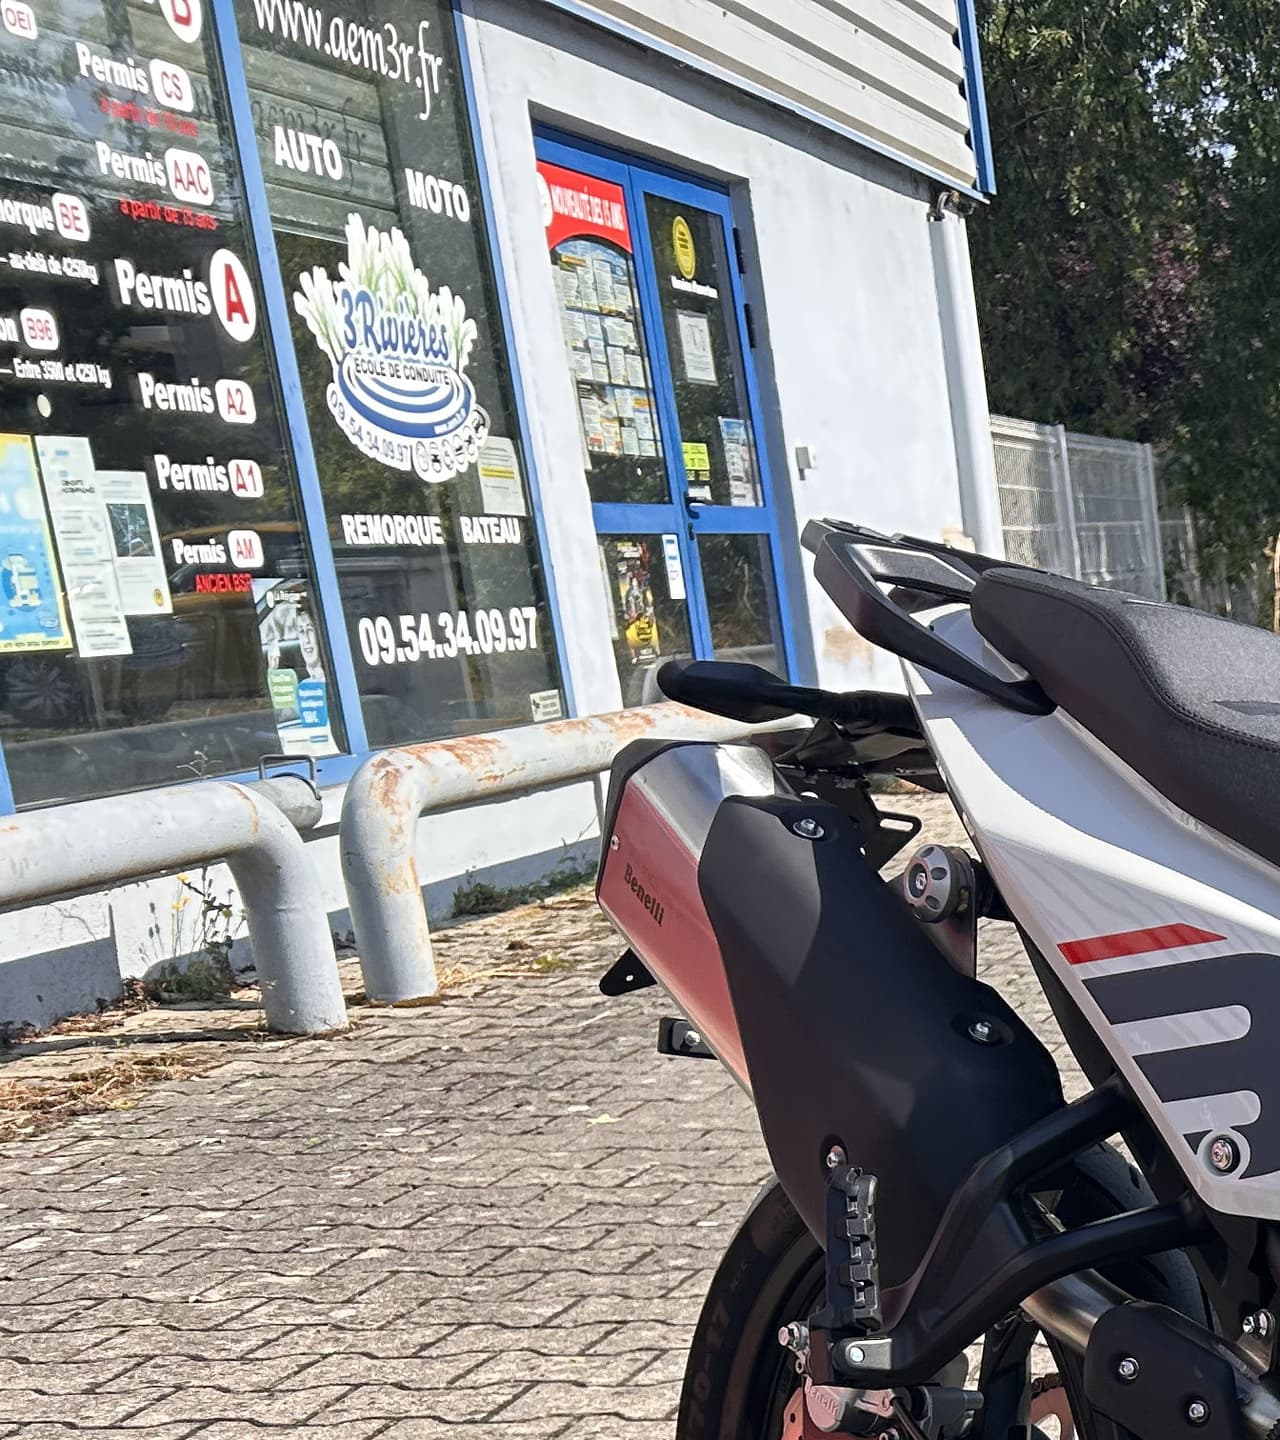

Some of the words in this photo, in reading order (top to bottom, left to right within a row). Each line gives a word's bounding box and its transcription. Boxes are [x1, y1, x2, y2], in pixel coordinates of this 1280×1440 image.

[75, 42, 150, 94] Permis
[161, 71, 184, 101] CS
[96, 141, 167, 187] Permis
[173, 159, 209, 196] AAC
[274, 125, 343, 181] AUTO
[404, 168, 471, 223] MOTO
[59, 202, 85, 234] BE
[113, 258, 212, 316] Permis
[224, 263, 250, 324] A
[26, 317, 54, 341] B96
[13, 357, 42, 380] Entre
[354, 357, 387, 377] ECOLE
[388, 362, 402, 379] DE
[403, 365, 451, 386] CONDUITE
[138, 372, 215, 414] Permis
[227, 387, 248, 416] A2
[154, 454, 230, 493] Permis
[235, 463, 258, 493] A1
[341, 514, 446, 547] REMORQUE
[459, 516, 521, 545] BATEAU
[172, 538, 227, 565] Permis
[236, 538, 256, 560] AM
[195, 573, 233, 593] ANCIEN
[358, 606, 538, 666] 09.54.34.09.97
[624, 862, 665, 927] Benelli
